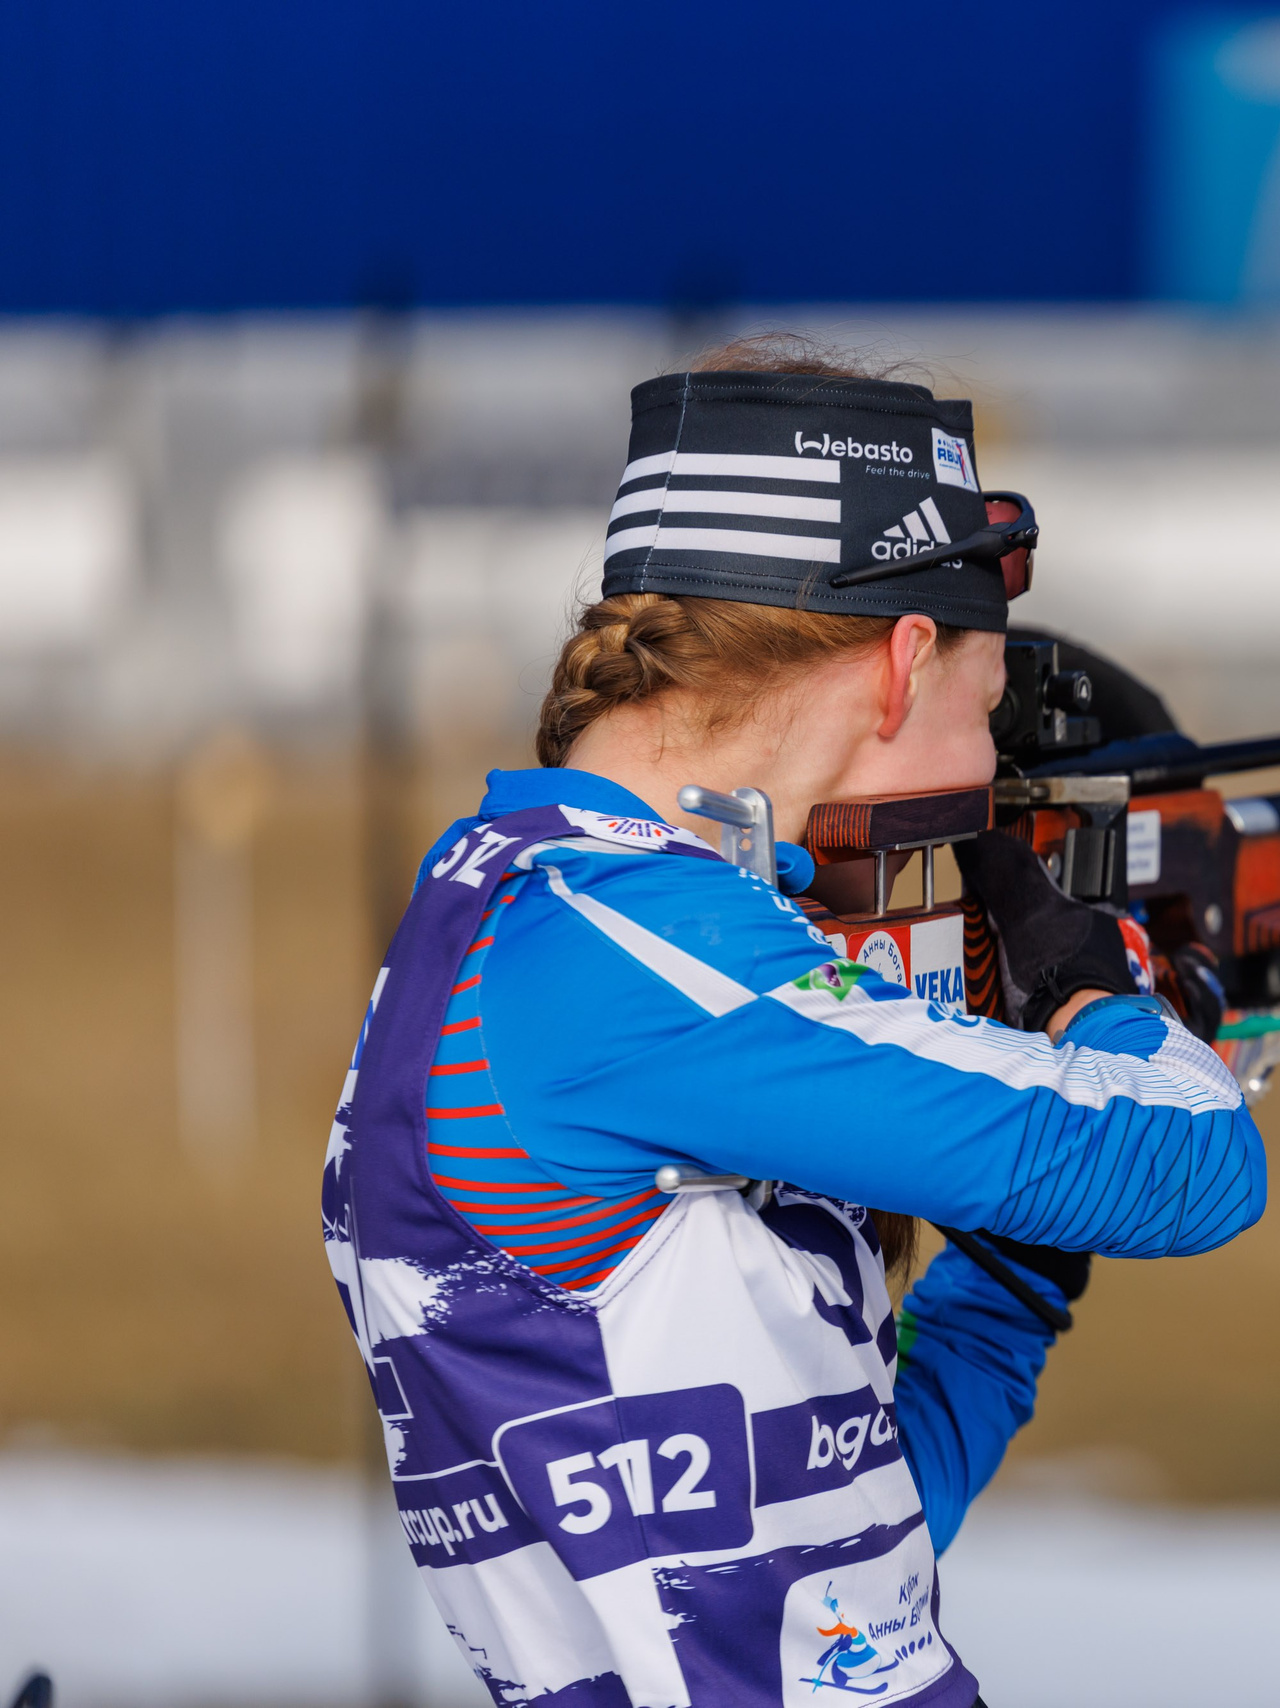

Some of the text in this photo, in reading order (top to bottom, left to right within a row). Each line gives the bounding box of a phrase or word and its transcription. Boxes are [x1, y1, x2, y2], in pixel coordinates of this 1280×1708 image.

[794, 431, 914, 464] Webasto
[865, 464, 931, 480] Feel the drive
[914, 966, 965, 1004] VEKA
[546, 1432, 718, 1535] 512
[867, 1615, 907, 1641] Анны
